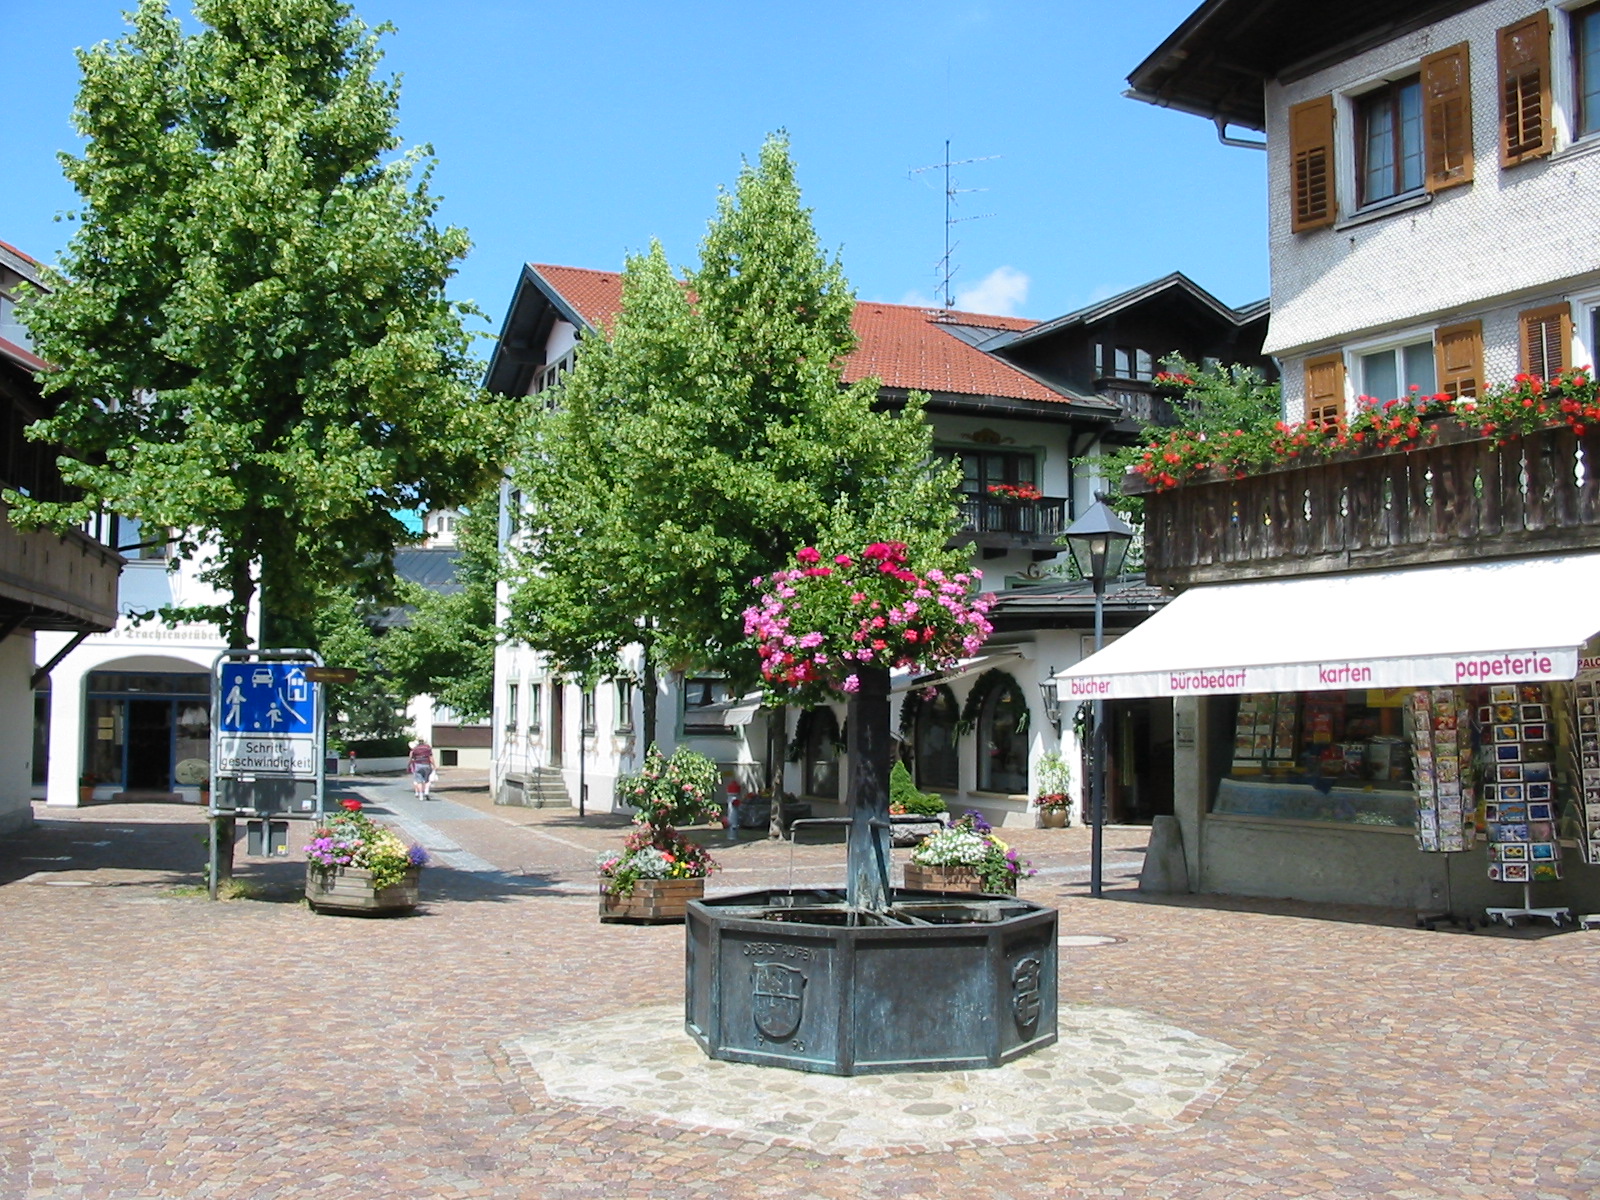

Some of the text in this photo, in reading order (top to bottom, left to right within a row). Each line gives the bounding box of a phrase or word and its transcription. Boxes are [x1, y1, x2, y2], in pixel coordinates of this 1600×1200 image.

[1071, 651, 1553, 695] bücher bürobedarf karten papeterie
[246, 741, 288, 754] Schritt-
[221, 755, 311, 770] geschwindigkeit
